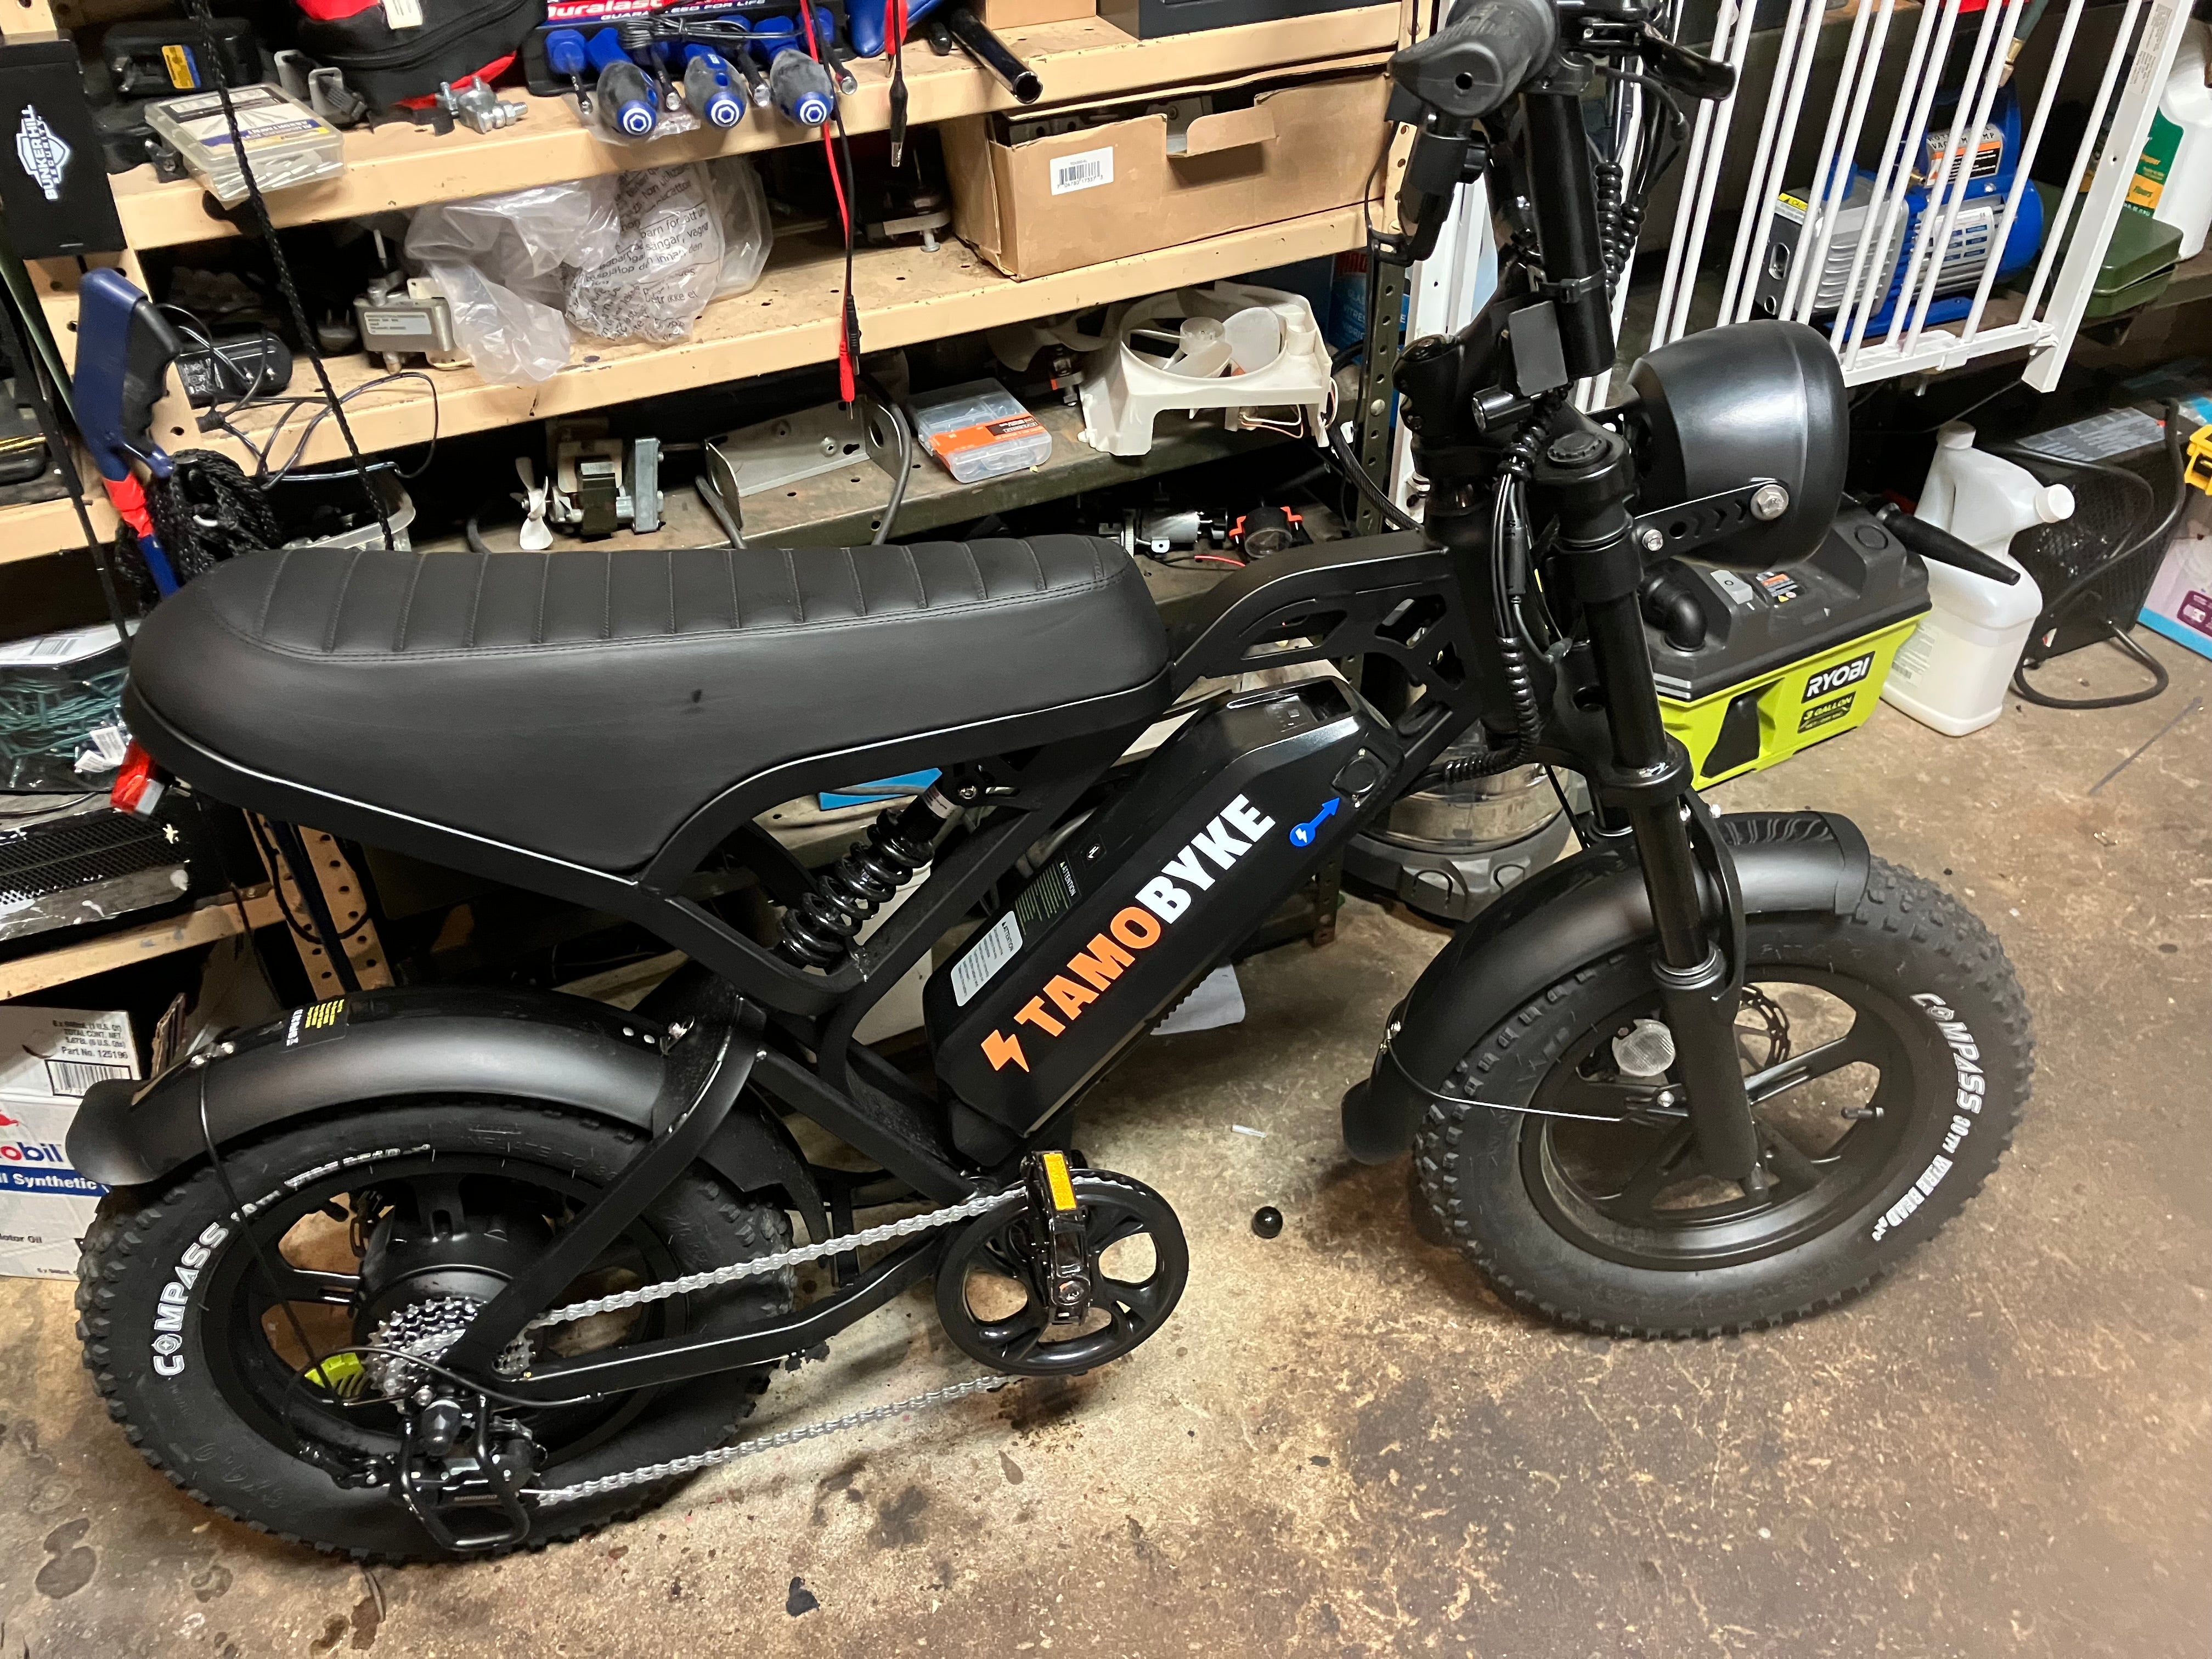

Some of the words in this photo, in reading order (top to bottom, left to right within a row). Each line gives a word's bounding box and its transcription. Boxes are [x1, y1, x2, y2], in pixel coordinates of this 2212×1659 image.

[21, 104, 58, 200] BUNKERHILL
[1807, 657, 1870, 697] RYOBI
[1060, 866, 1077, 896] ATTENTION
[1014, 793, 1276, 1037] TAMOBYKE
[1002, 926, 1014, 952] ATTENTION
[61, 1046, 80, 1056] Part
[81, 1048, 95, 1057] No.
[1910, 993, 1985, 1114] COMPASS
[0, 1142, 63, 1162] obil
[13, 1173, 98, 1190] Synthetic
[1916, 1154, 1953, 1197] WIRE
[1886, 1187, 1925, 1227] BEAD
[151, 1222, 229, 1376] COMPASS
